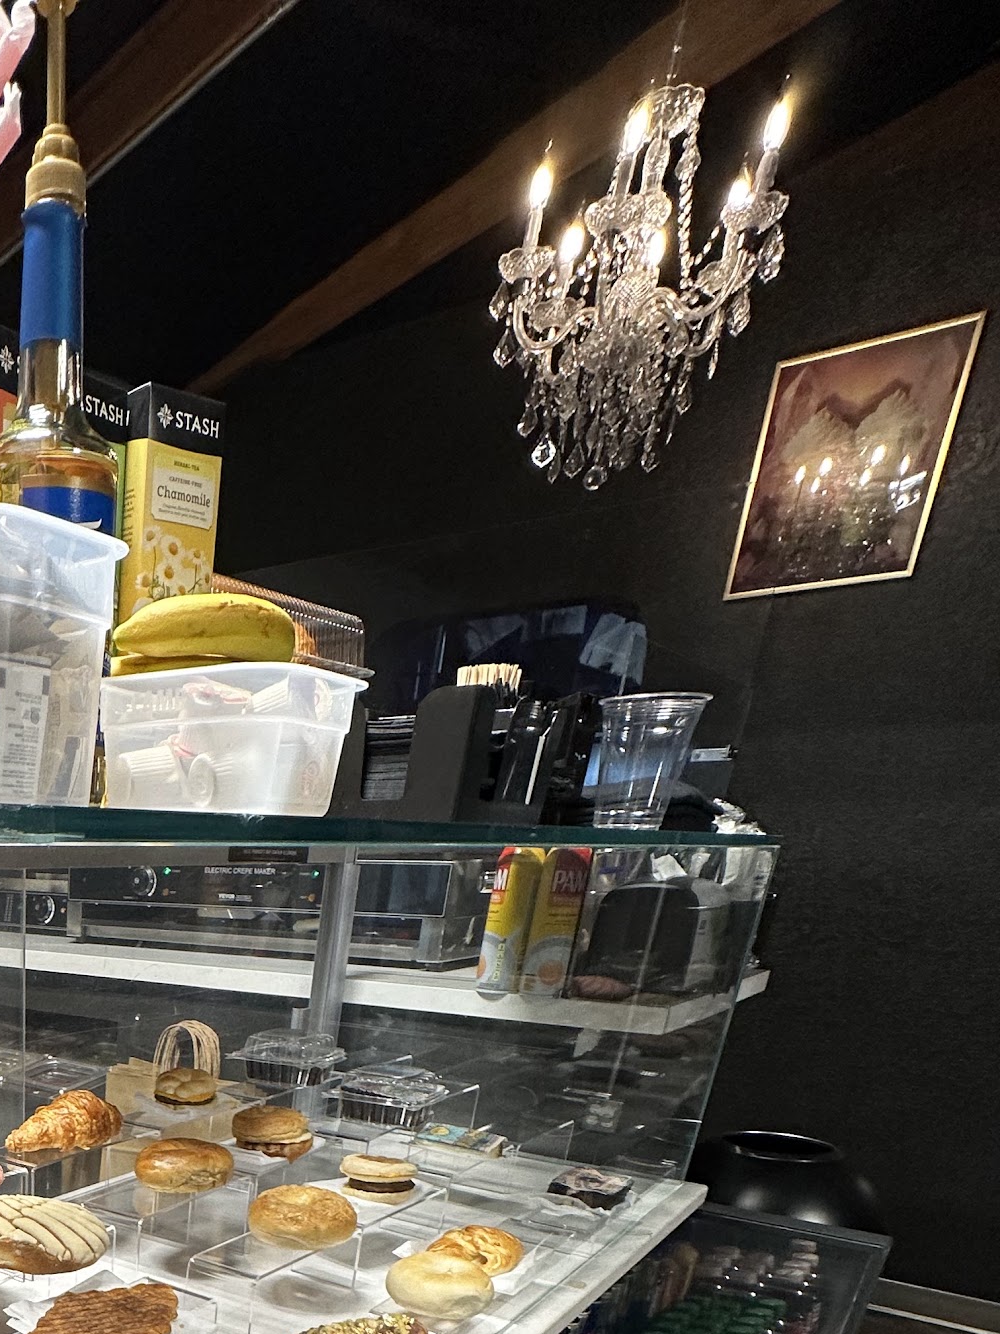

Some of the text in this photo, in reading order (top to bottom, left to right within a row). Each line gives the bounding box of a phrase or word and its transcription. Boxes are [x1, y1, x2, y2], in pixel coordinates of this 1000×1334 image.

[85, 394, 124, 426] STASH
[175, 410, 220, 439] STASH
[157, 485, 211, 508] Chamomile
[233, 867, 253, 875] CREPE
[254, 867, 276, 875] MAKER
